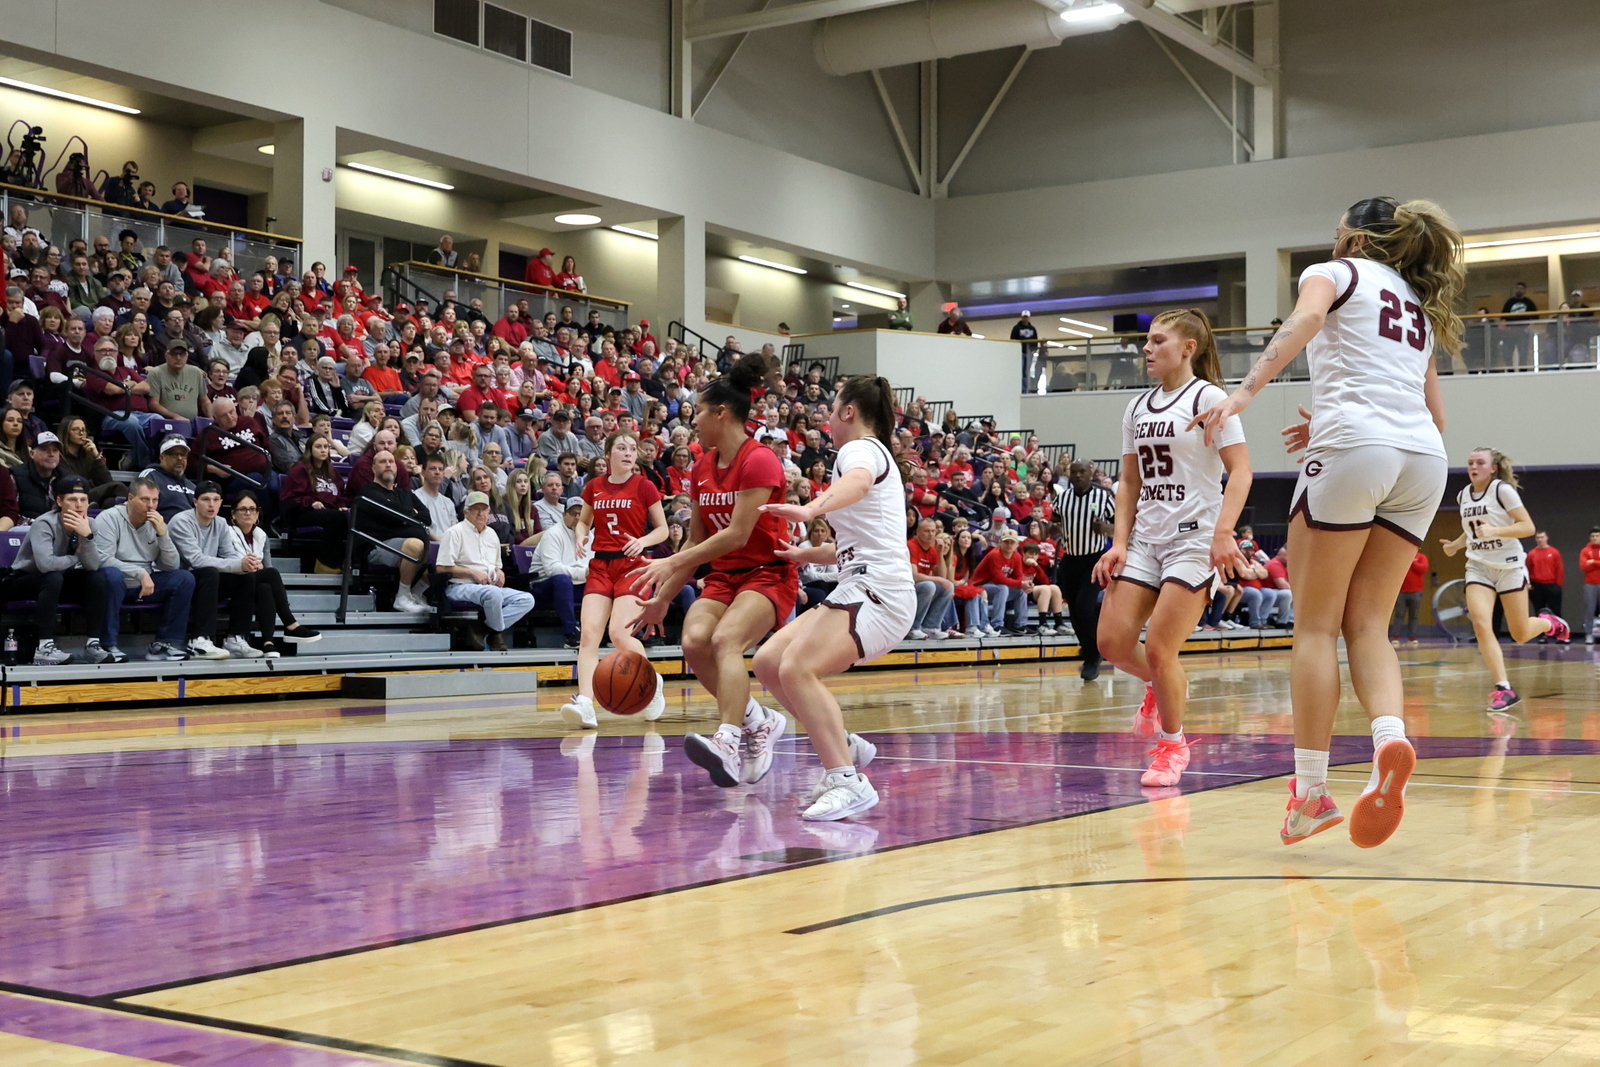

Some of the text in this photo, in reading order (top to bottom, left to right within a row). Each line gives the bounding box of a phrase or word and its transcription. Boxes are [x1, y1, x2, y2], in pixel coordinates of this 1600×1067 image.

[1379, 289, 1426, 352] 23
[1135, 421, 1175, 439] GENOA
[1138, 444, 1174, 479] 25
[1305, 460, 1323, 477] G
[593, 499, 632, 510] BELLEVUE
[1463, 505, 1488, 518] GENOA
[606, 513, 620, 535] 2
